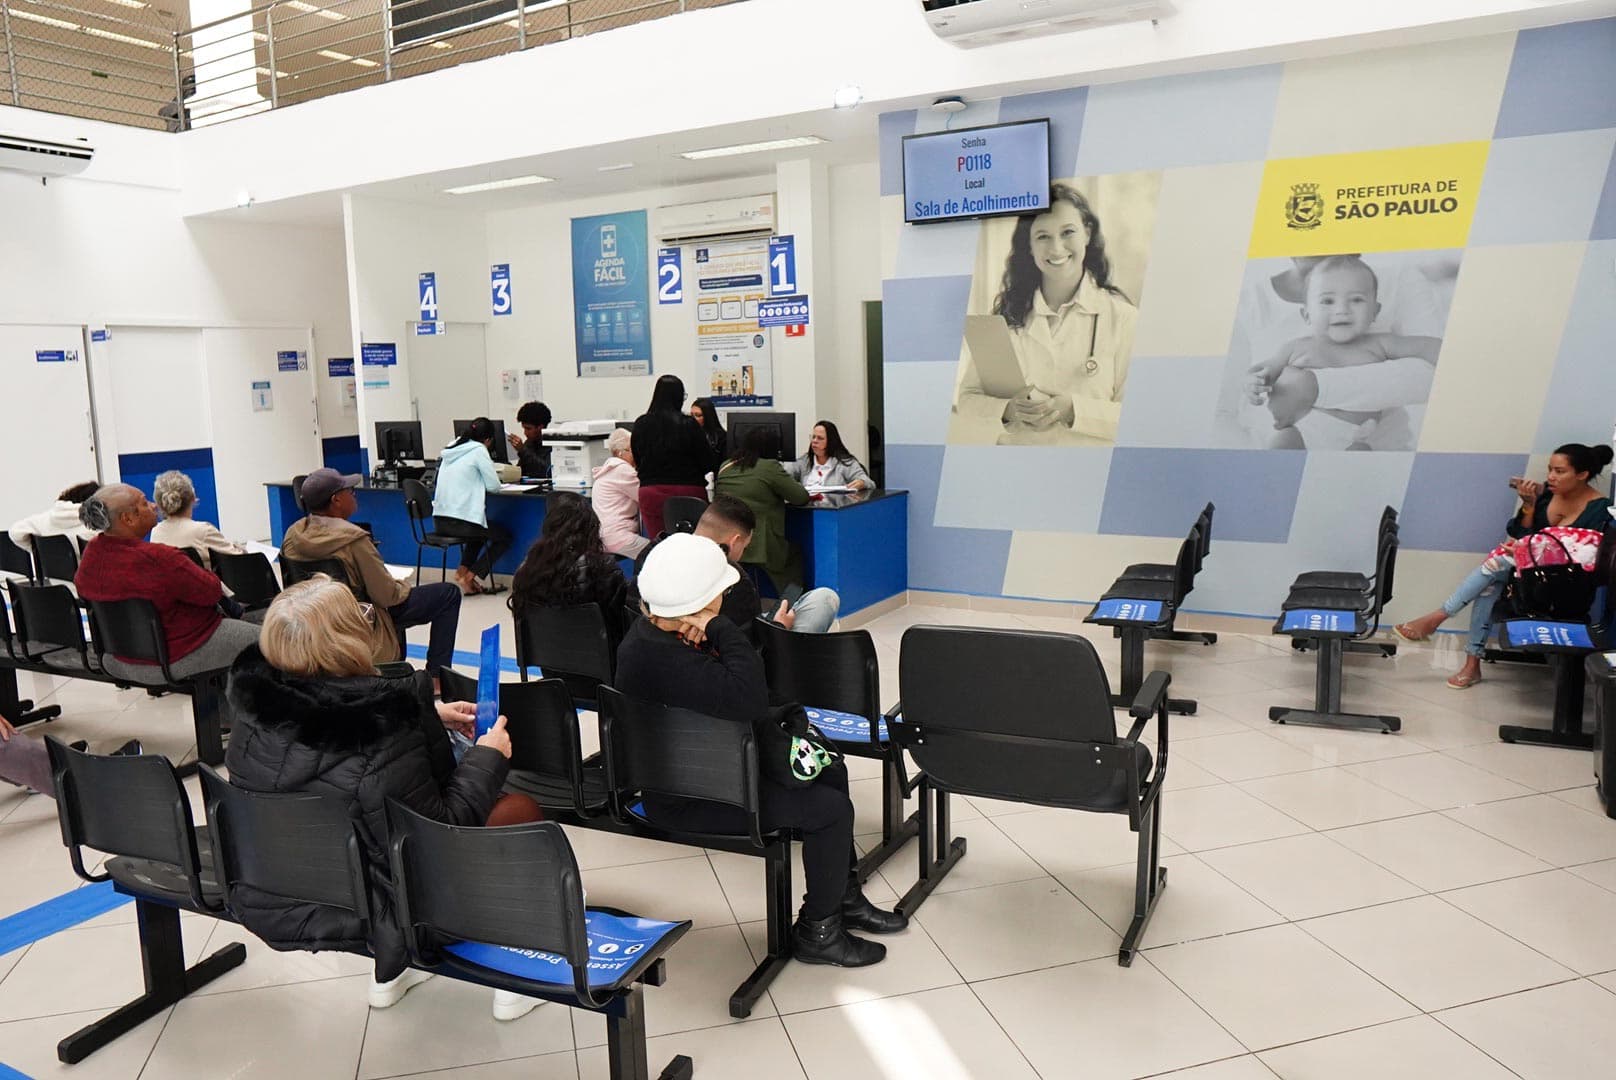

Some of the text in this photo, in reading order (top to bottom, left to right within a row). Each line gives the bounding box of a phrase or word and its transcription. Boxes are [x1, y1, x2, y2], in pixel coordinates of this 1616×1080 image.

[961, 137, 986, 149] Senha
[957, 153, 992, 172] P0118
[965, 178, 985, 190] Local
[1336, 180, 1458, 200] PREFEITURA DE
[914, 192, 1039, 217] Sala de Acolhimento
[1335, 197, 1458, 220] SÃO PAULO
[595, 257, 625, 268] AGENDA
[771, 253, 795, 292] 1
[594, 267, 626, 282] FÁCIL
[659, 263, 682, 301] 2
[421, 286, 438, 318] 4
[493, 278, 510, 313] 3
